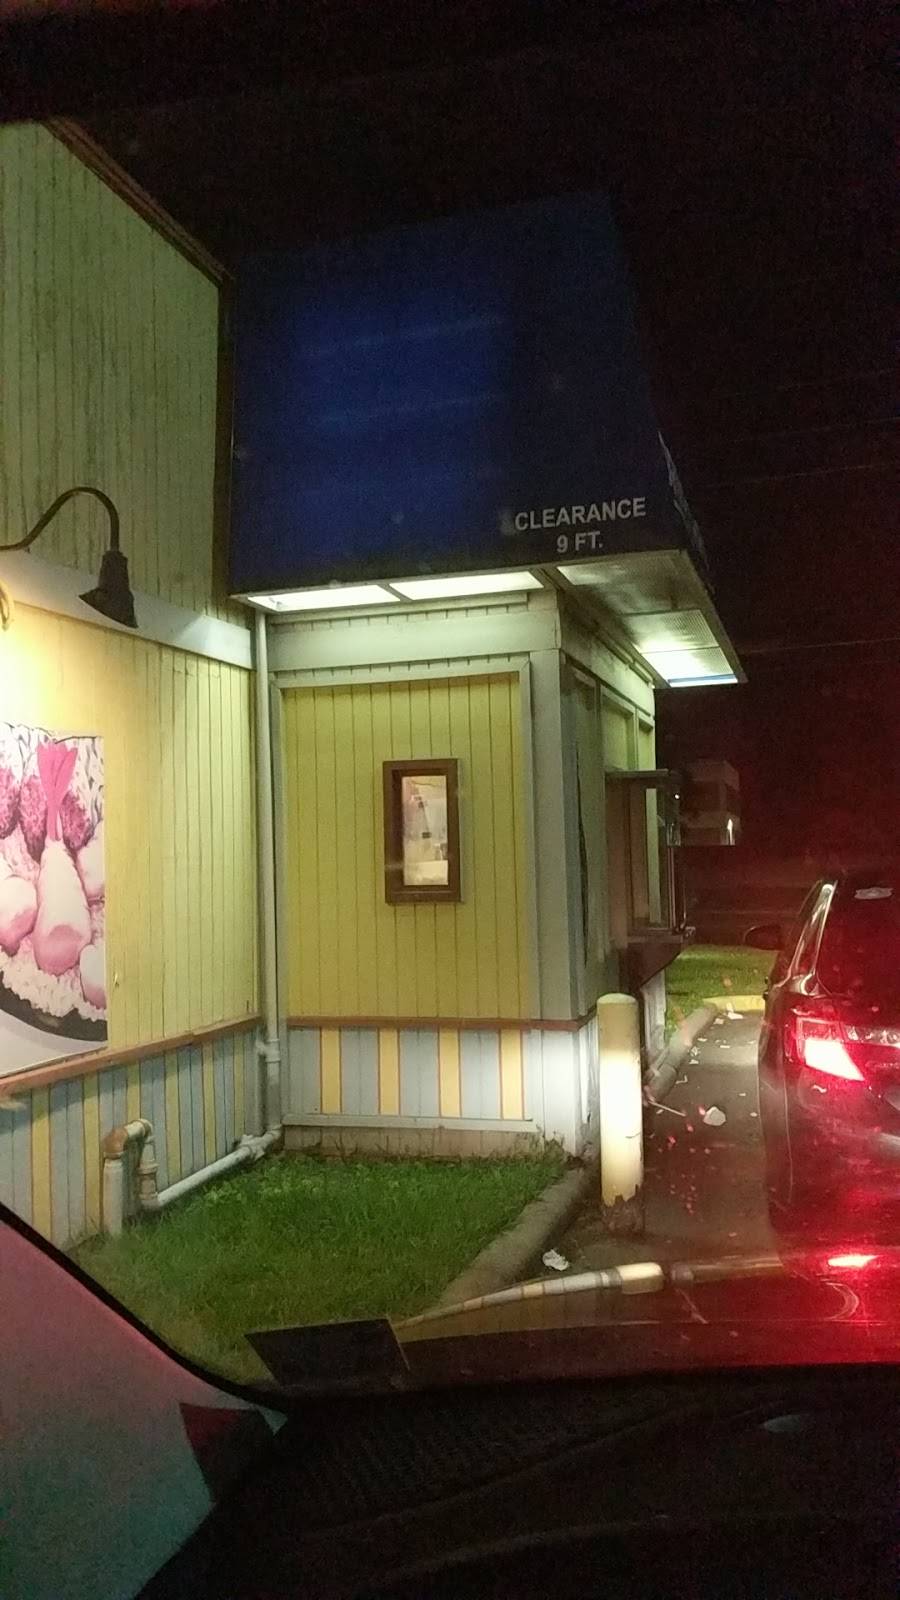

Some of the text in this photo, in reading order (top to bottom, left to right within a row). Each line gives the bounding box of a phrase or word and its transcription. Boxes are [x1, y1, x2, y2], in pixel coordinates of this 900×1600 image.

[515, 497, 647, 531] CLEARANCE
[557, 531, 603, 553] 9 FT.
